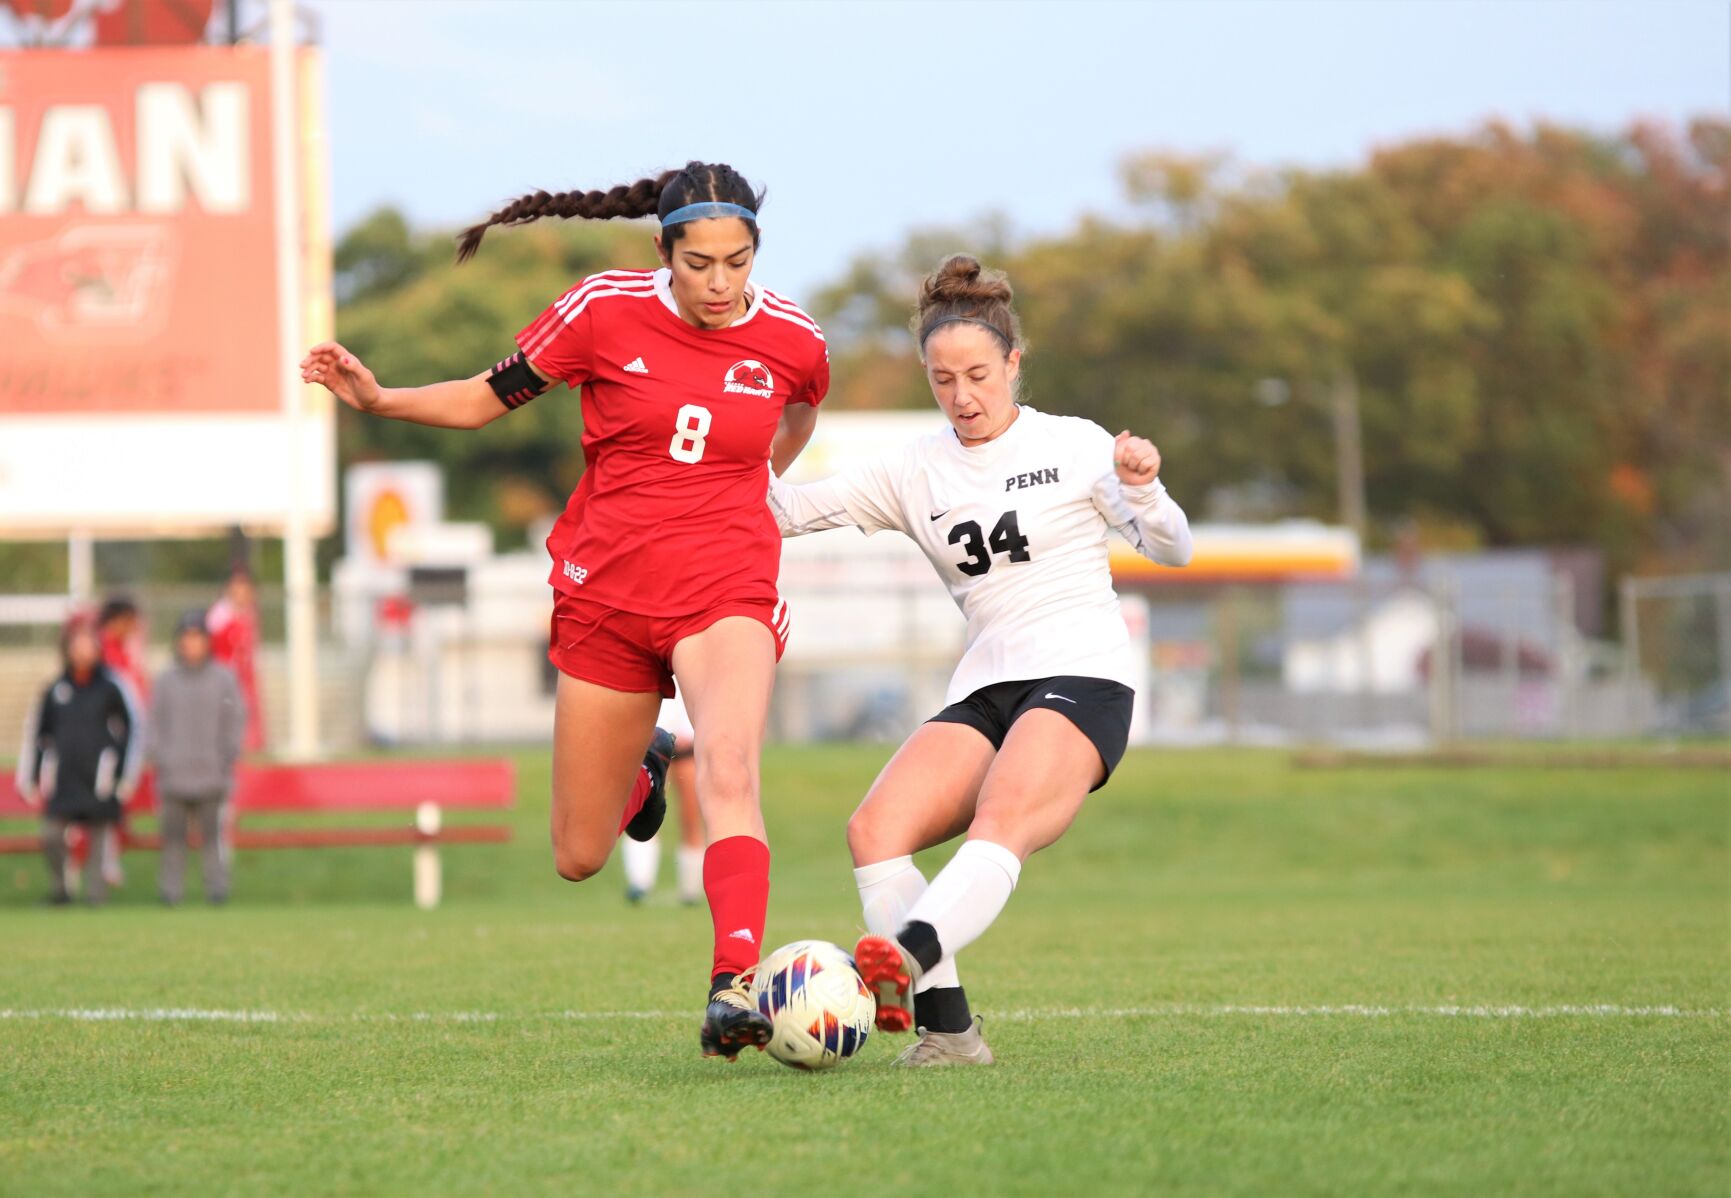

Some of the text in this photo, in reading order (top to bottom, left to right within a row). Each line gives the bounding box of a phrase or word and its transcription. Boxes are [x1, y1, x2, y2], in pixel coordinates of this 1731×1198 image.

[669, 404, 712, 464] 8
[1005, 468, 1059, 492] PENN
[948, 510, 1030, 576] 34
